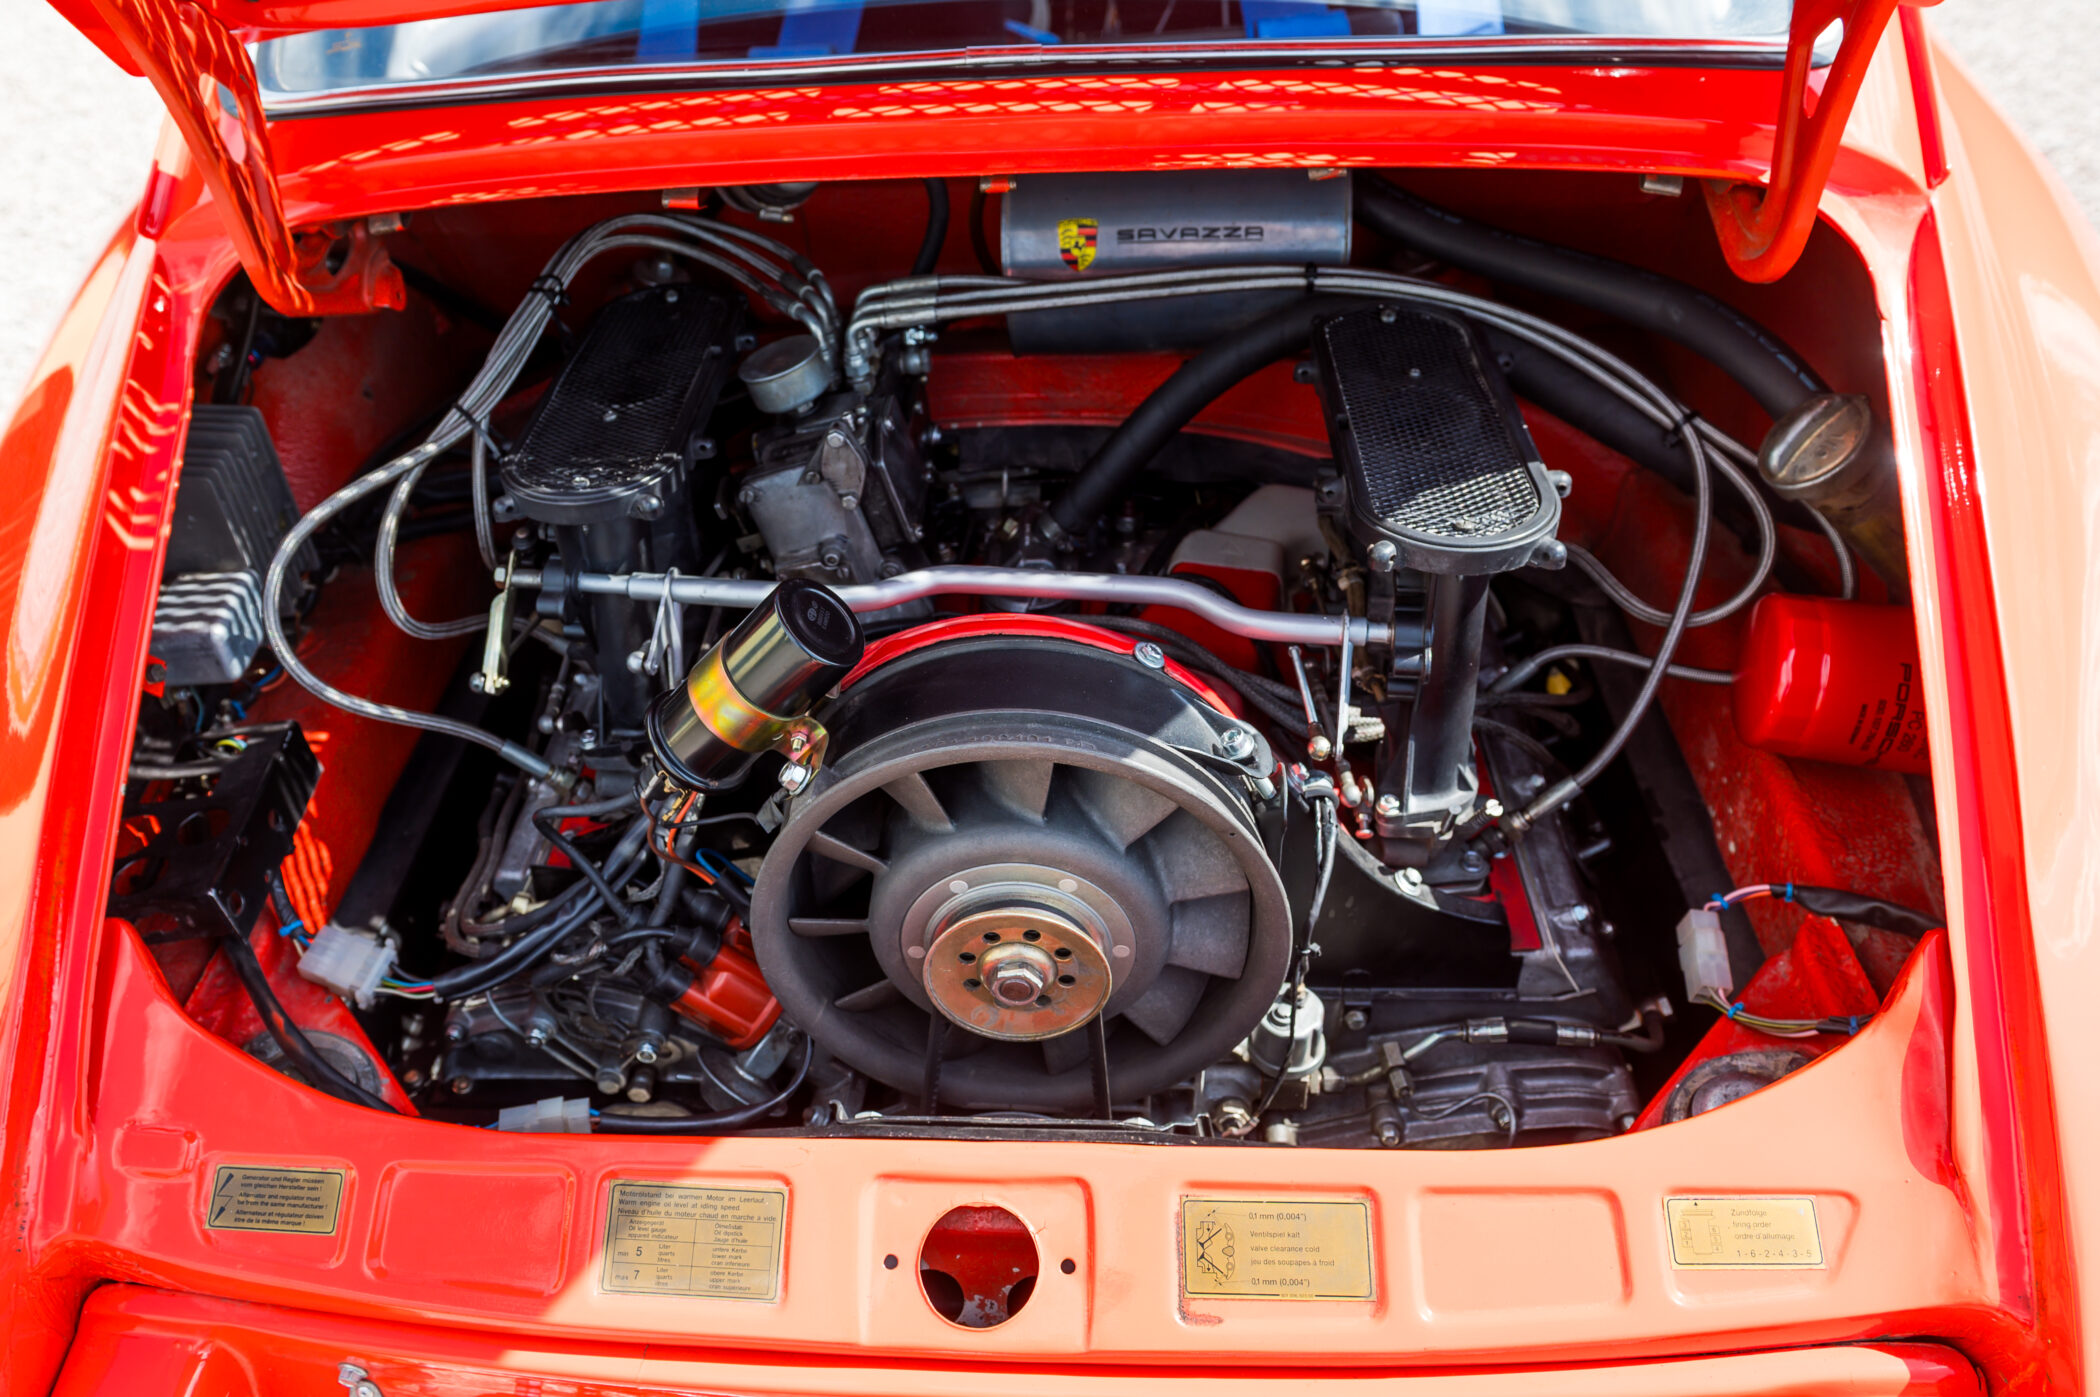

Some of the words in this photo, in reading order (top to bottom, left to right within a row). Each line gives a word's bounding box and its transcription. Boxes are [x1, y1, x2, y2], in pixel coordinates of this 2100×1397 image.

[1117, 226, 1264, 241] SAVAZZA
[1863, 663, 1913, 766] PORSC
[619, 1198, 637, 1206] Warm
[640, 1200, 661, 1208] engine
[618, 1207, 639, 1215] Niveau
[1250, 1230, 1286, 1239] Ventilspiel
[1735, 1232, 1754, 1240] ordre
[636, 1246, 643, 1257] 5
[1251, 1259, 1262, 1267] jeu
[1278, 1259, 1311, 1267] soupapes
[634, 1270, 640, 1280] 7
